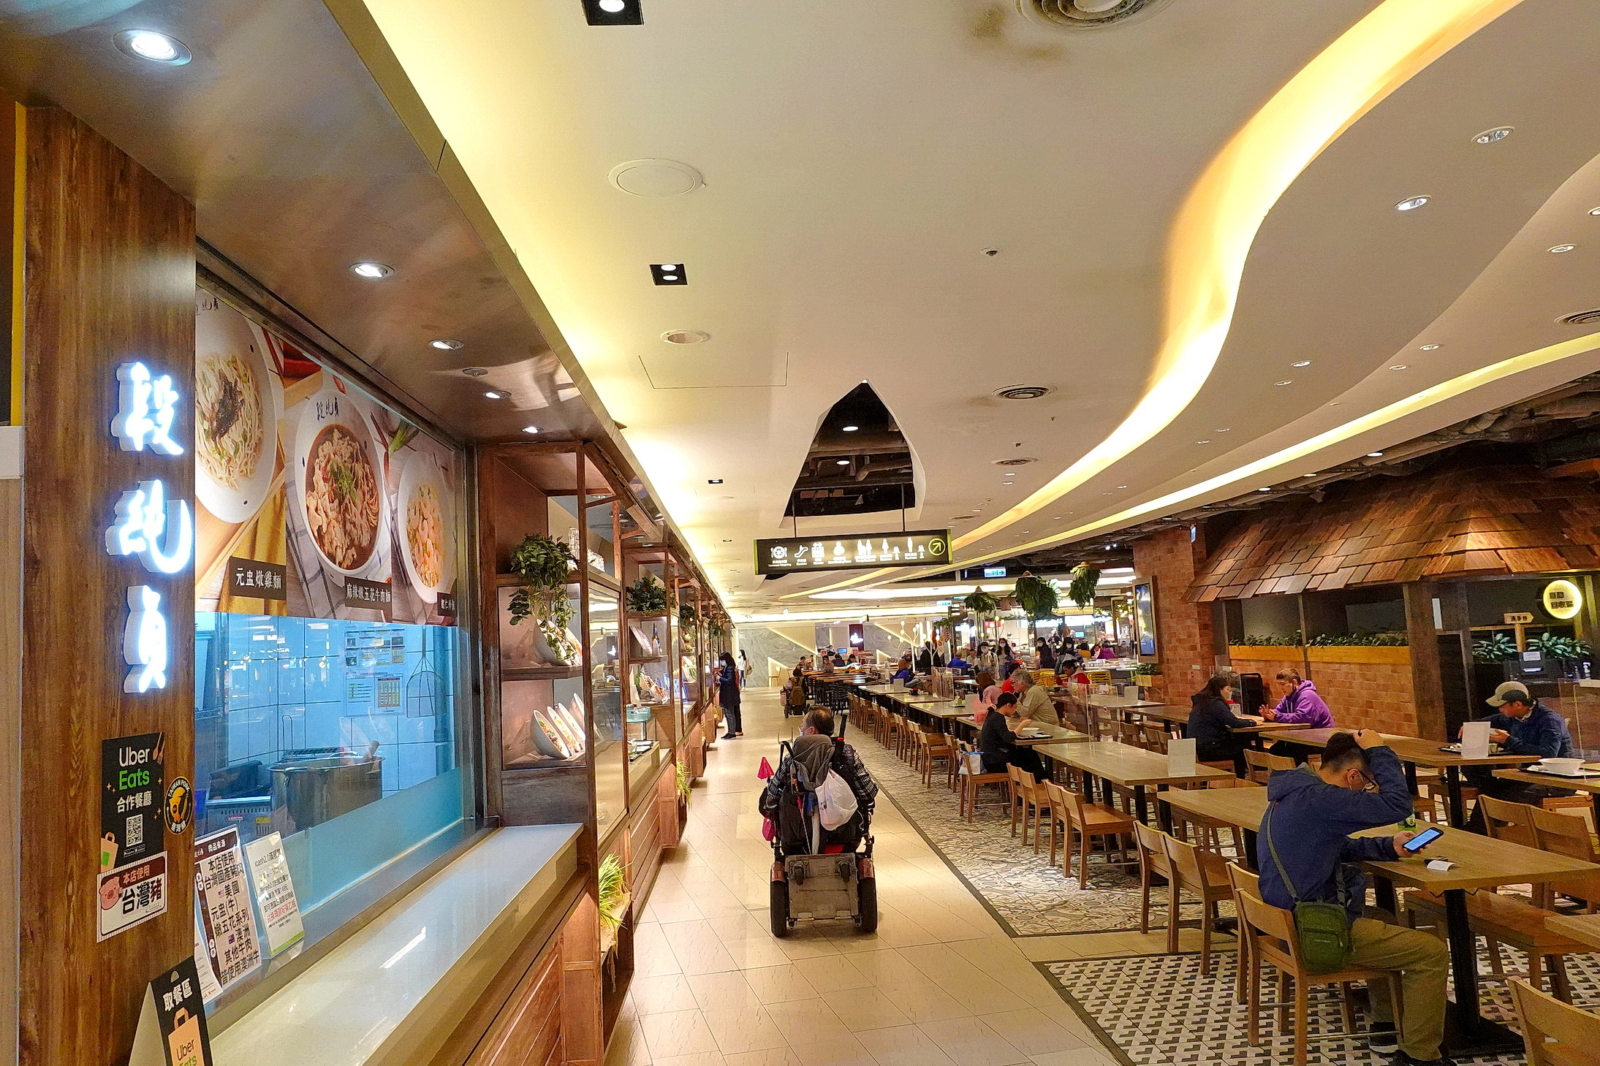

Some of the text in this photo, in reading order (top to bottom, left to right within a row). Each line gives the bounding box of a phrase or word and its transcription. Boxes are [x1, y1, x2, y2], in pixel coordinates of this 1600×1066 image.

[119, 747, 150, 766] Uber
[119, 769, 150, 791] Eats
[117, 791, 152, 814] 合作餐廳
[208, 850, 234, 872] 本店使用
[122, 865, 150, 885] 本店使用
[121, 879, 162, 914] 台灣豬
[224, 881, 239, 898] 美國
[235, 924, 250, 943] 澳洲
[224, 938, 252, 966] 其他牛肉
[163, 978, 193, 1012] 取餐區
[176, 1039, 195, 1061] Uber
